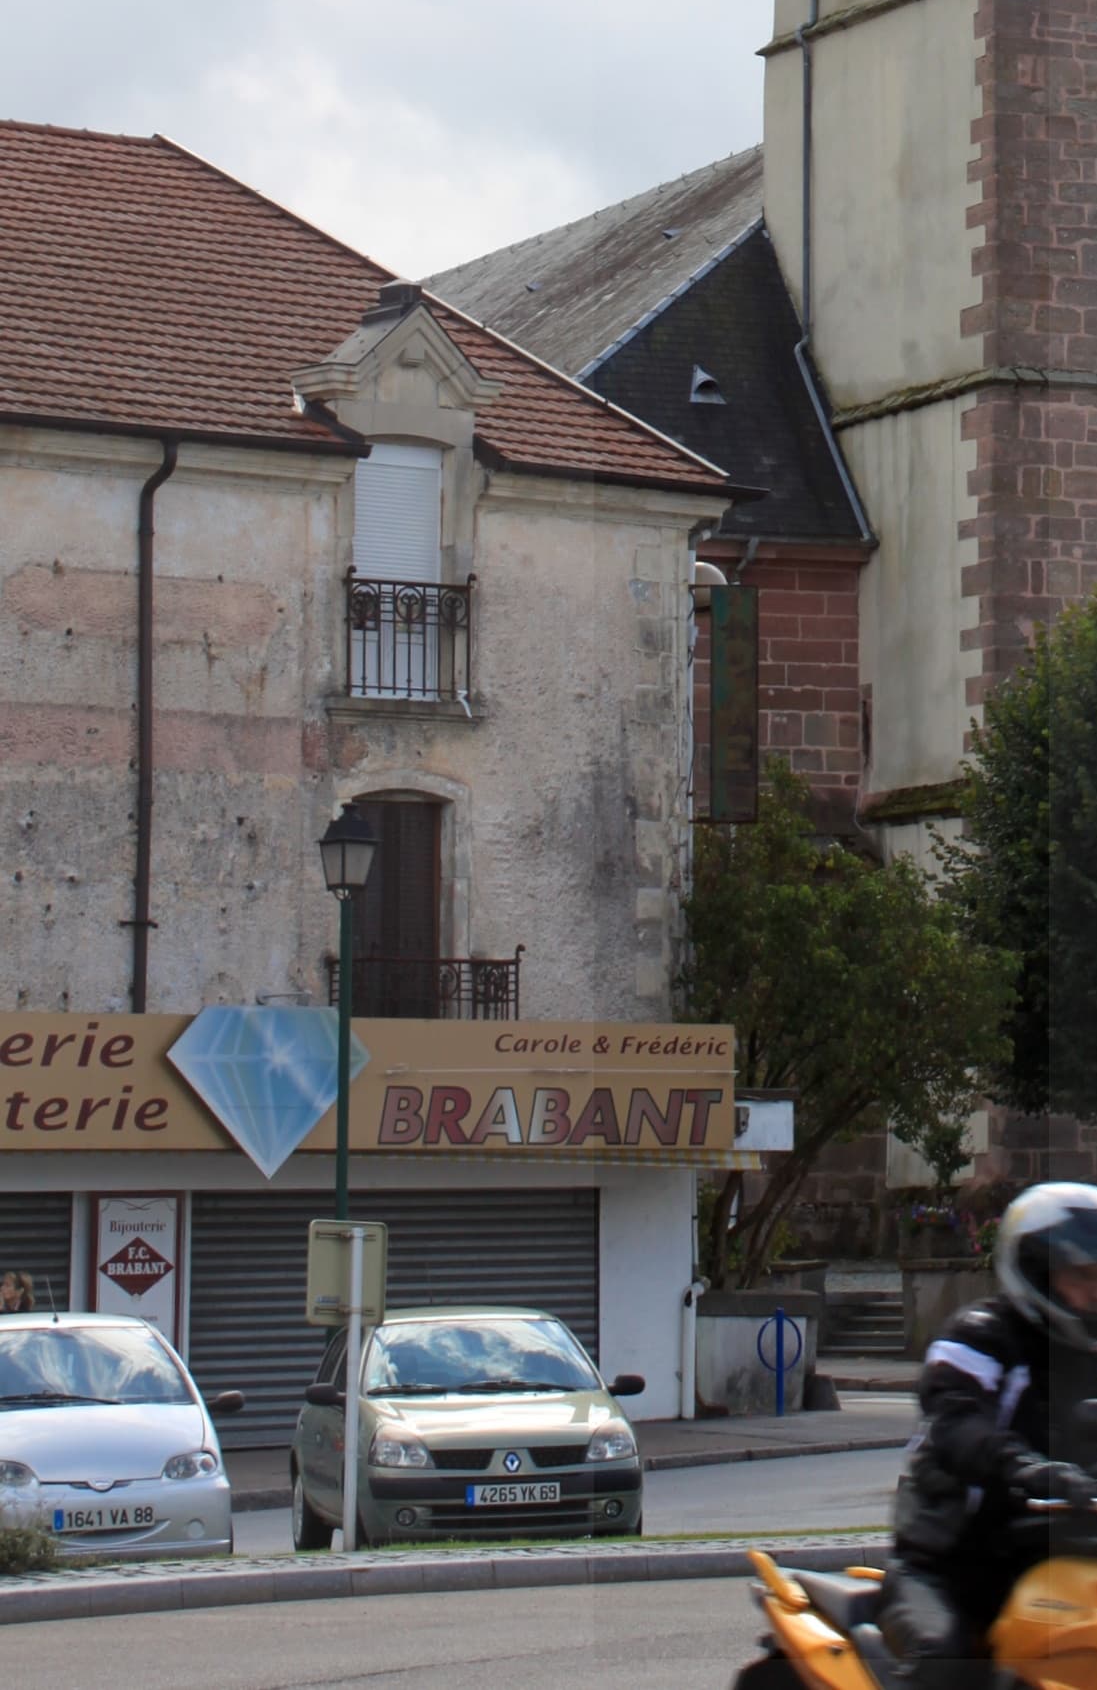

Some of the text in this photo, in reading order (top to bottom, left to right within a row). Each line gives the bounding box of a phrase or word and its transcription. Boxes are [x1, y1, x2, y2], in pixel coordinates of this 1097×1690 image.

[0, 1022, 134, 1068] erie
[494, 1033, 728, 1056] Carole & Frédéric
[6, 1085, 169, 1131] terie
[377, 1086, 723, 1145] BRABANT
[109, 1220, 167, 1235] Bijouterie
[128, 1247, 149, 1259] F.C.
[107, 1262, 166, 1275] BRABANT
[480, 1485, 557, 1502] 4265 YK 69
[67, 1506, 153, 1528] 1641 VA 88
